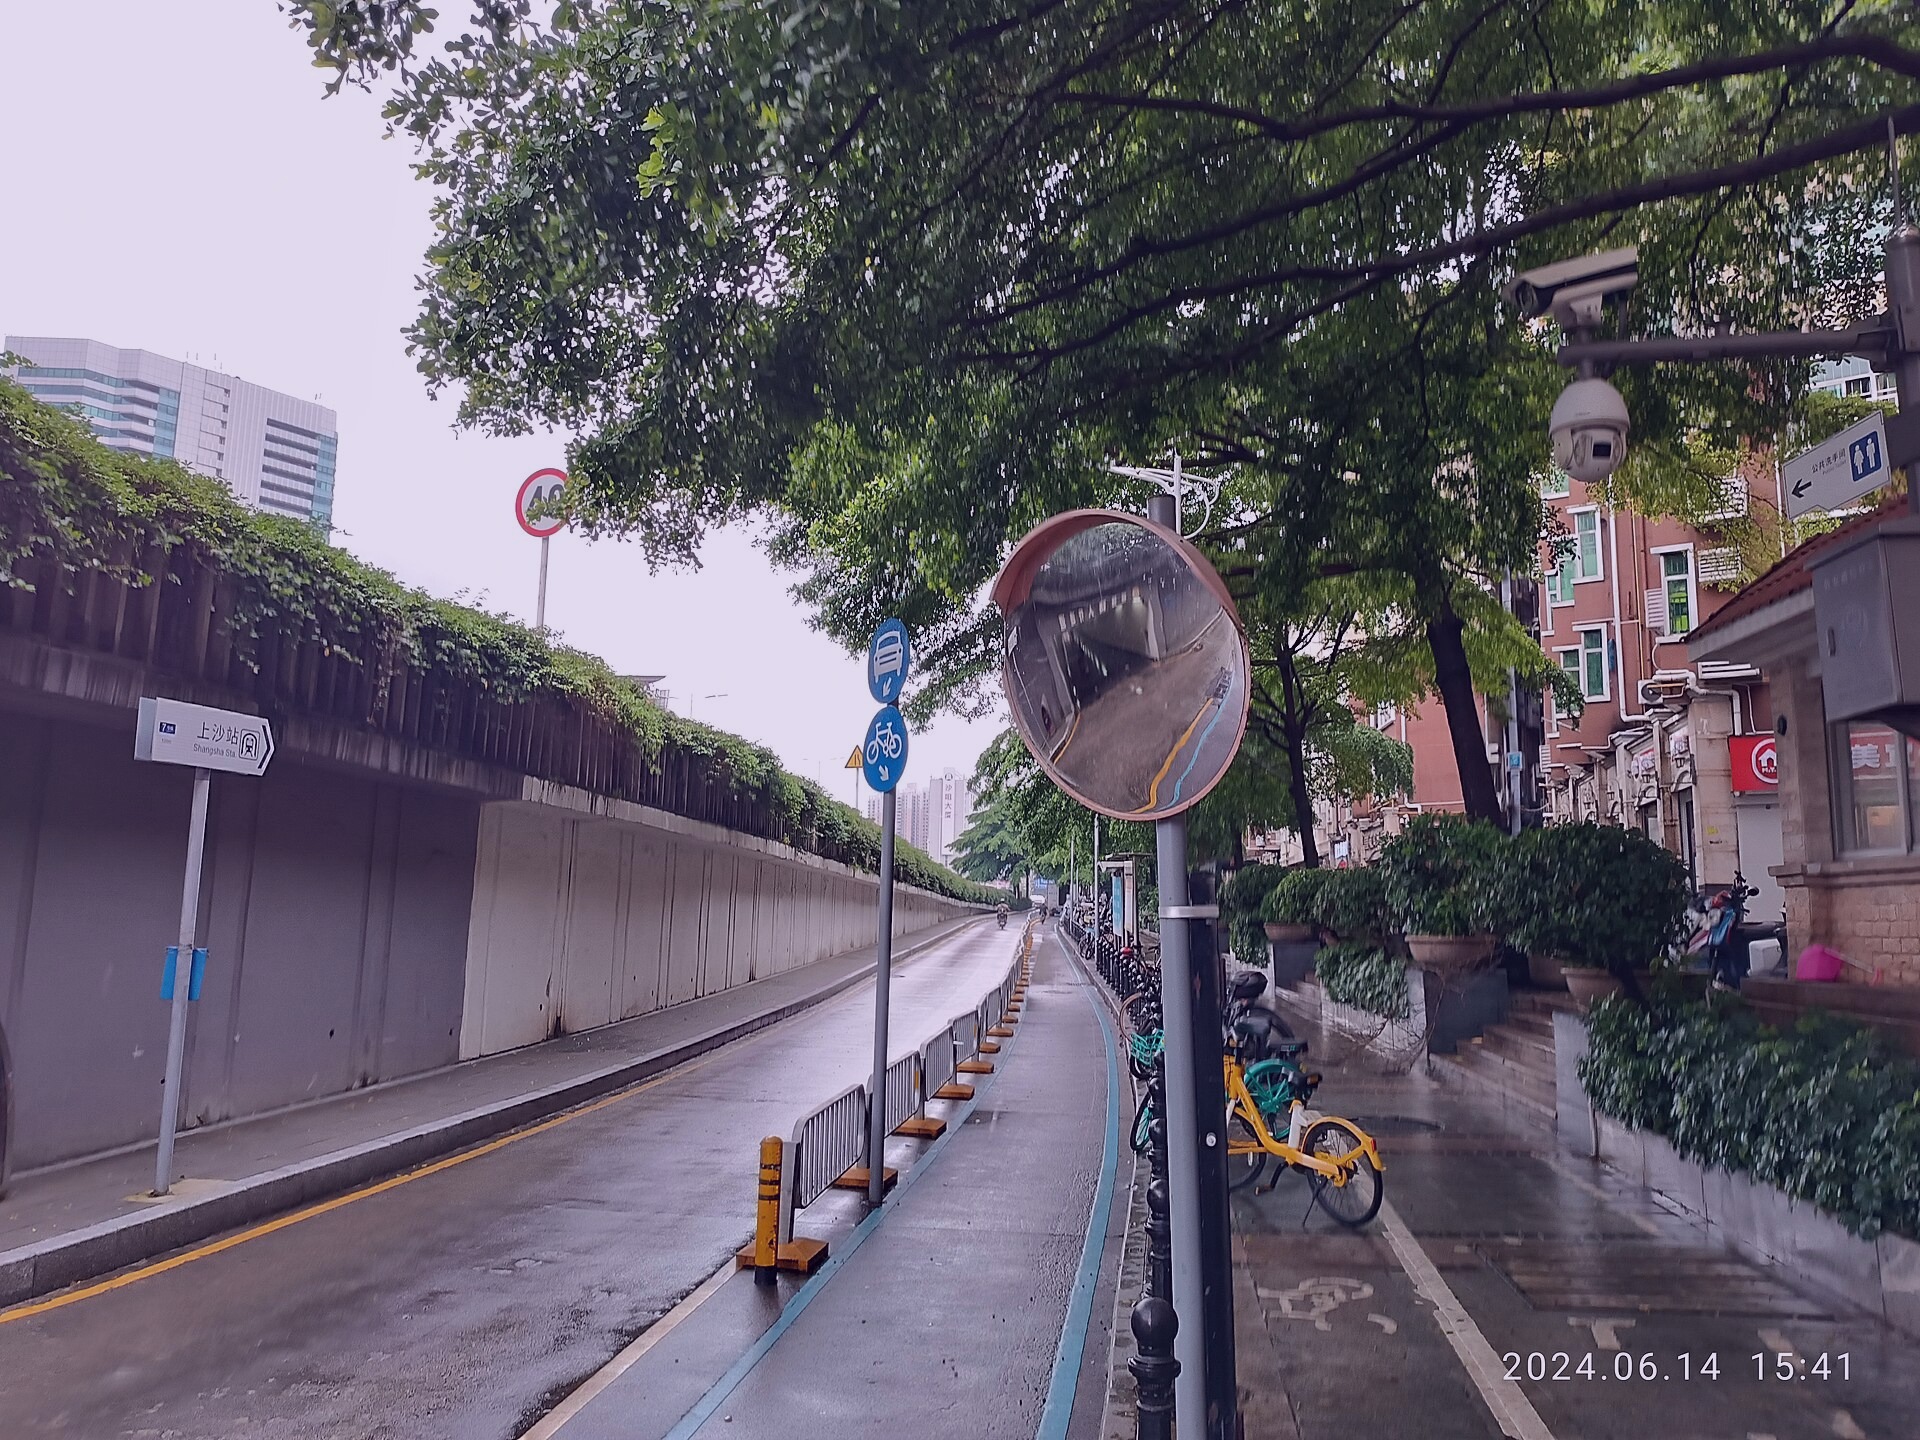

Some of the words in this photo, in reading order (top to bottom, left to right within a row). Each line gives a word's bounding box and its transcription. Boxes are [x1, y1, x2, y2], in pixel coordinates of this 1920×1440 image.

[1812, 448, 1846, 473] 公共洗手间
[197, 721, 240, 745] 上沙站
[193, 743, 225, 757] Shangsha
